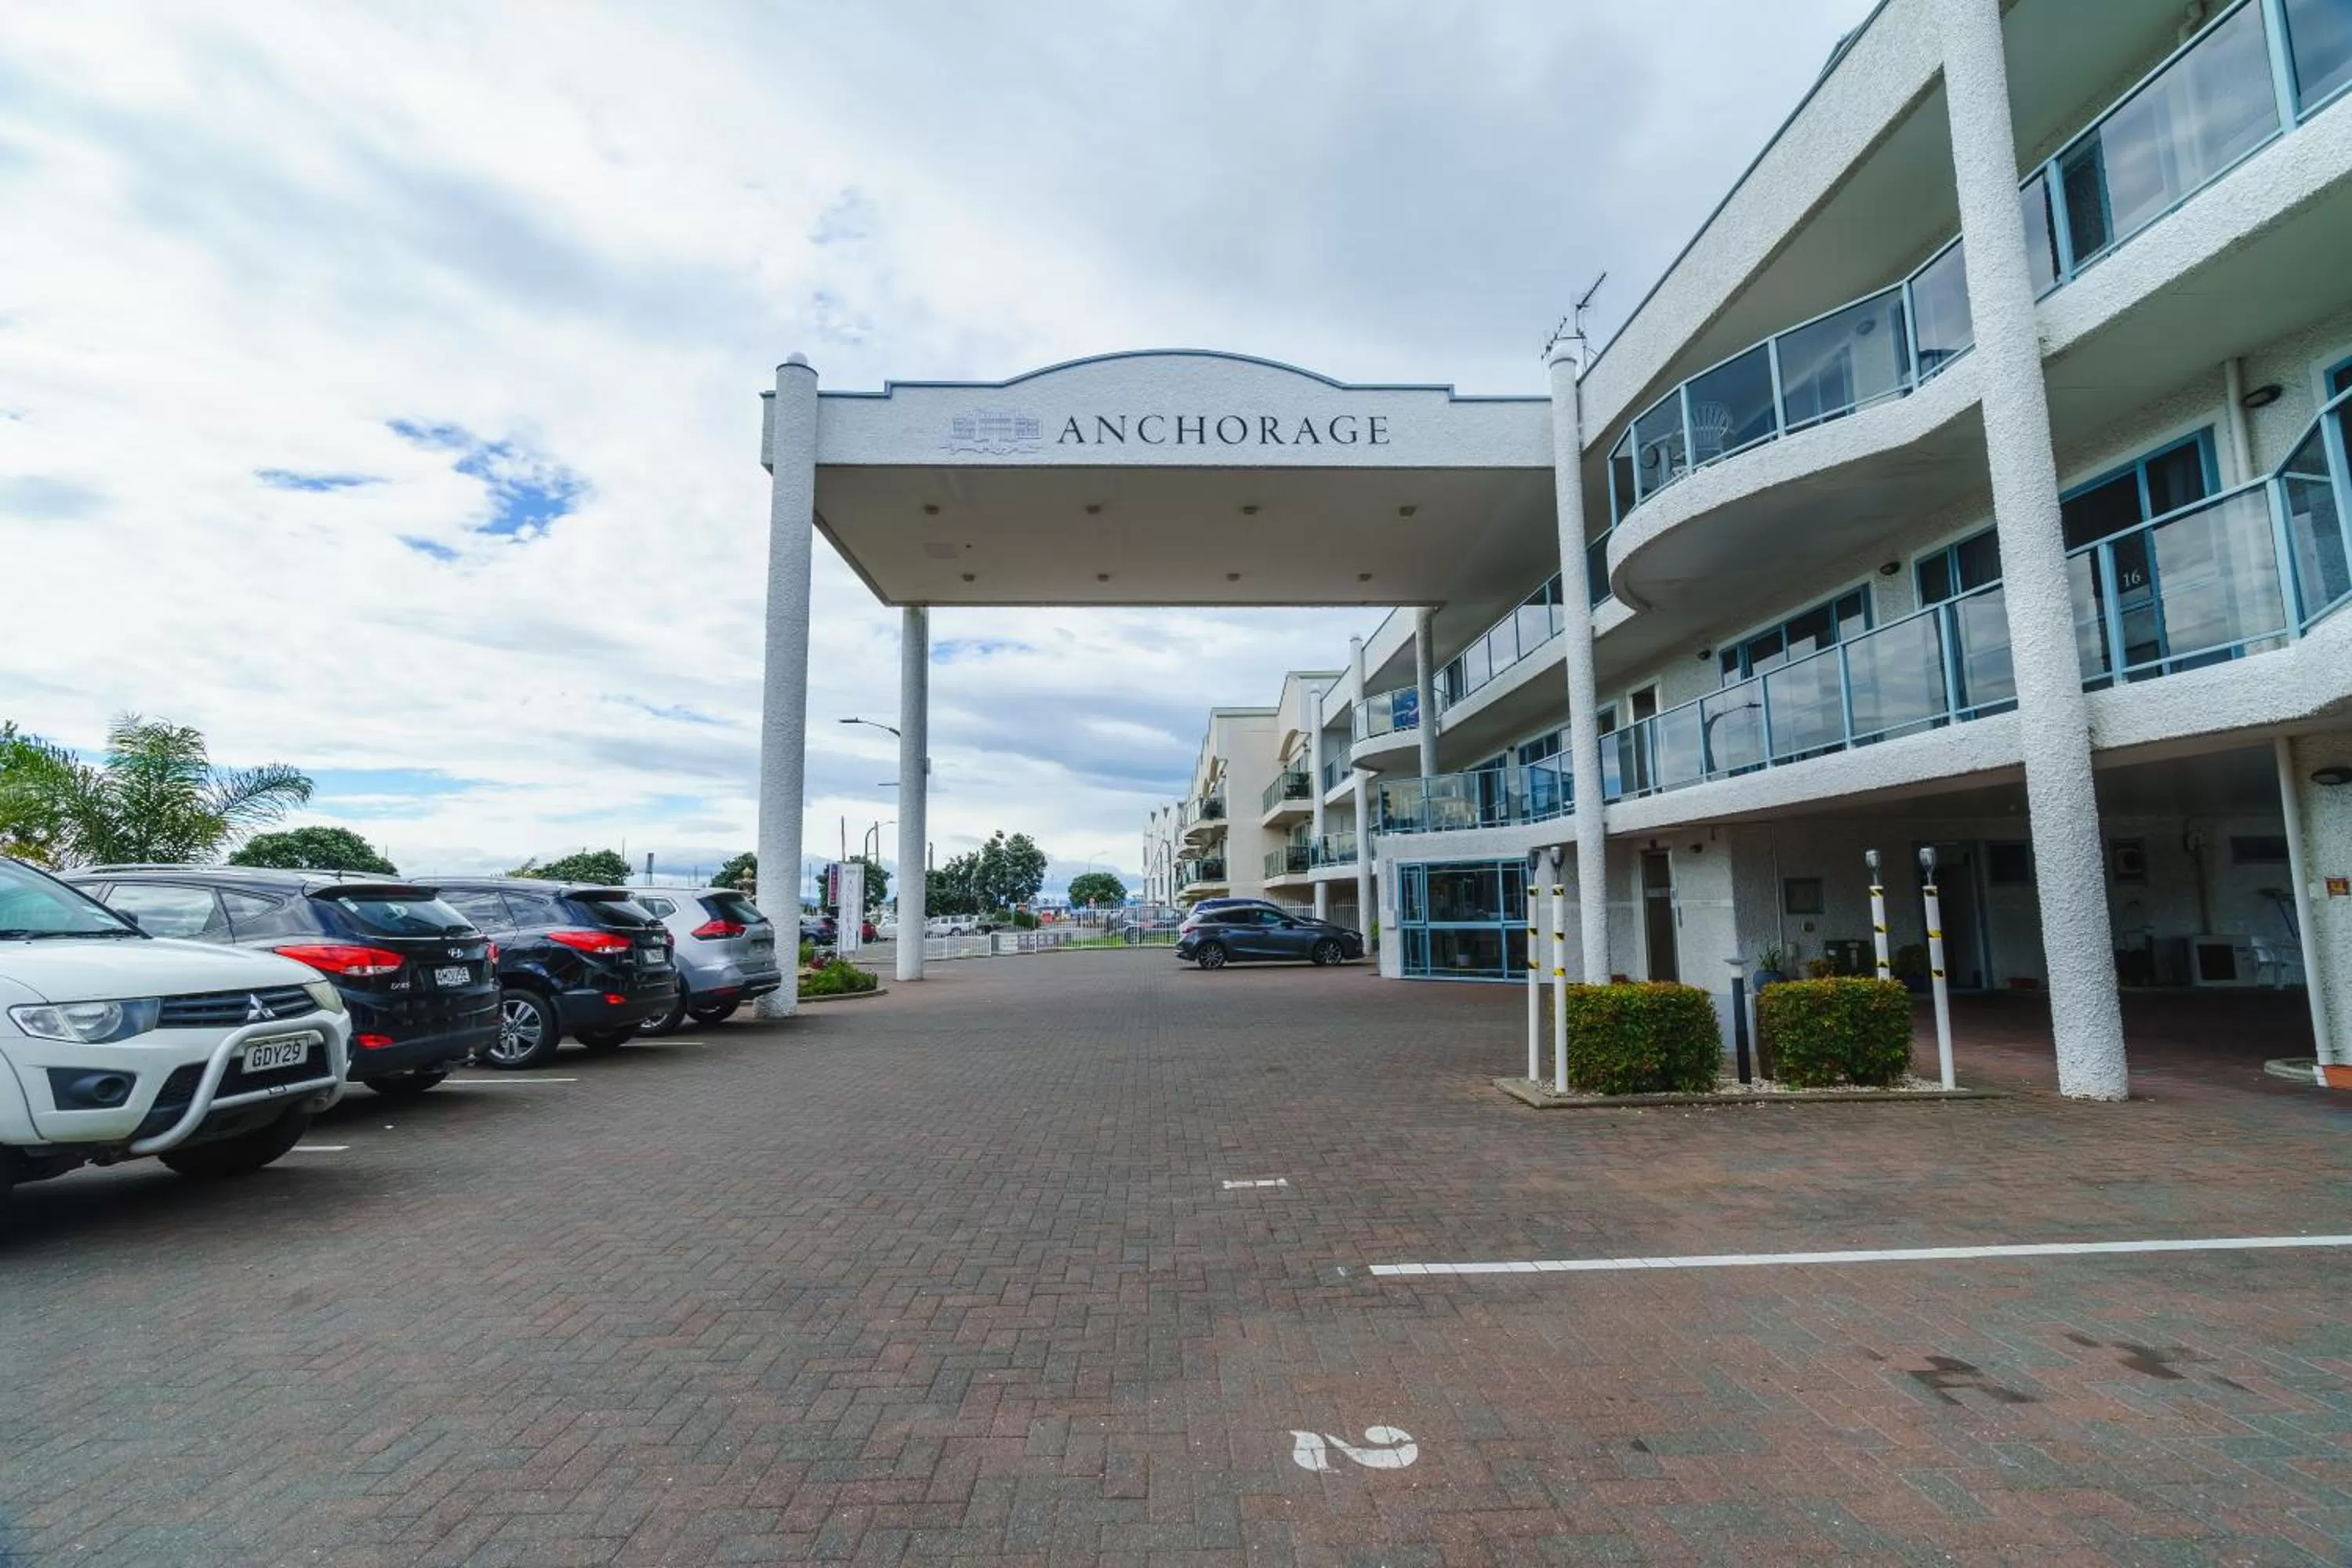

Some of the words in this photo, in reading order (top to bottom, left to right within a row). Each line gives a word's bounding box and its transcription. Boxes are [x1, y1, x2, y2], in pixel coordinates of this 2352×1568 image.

[1058, 413, 1391, 445] ANCHORAGE
[2122, 568, 2140, 587] 16
[252, 1044, 301, 1067] GDY29
[1290, 1425, 1419, 1473] 2
